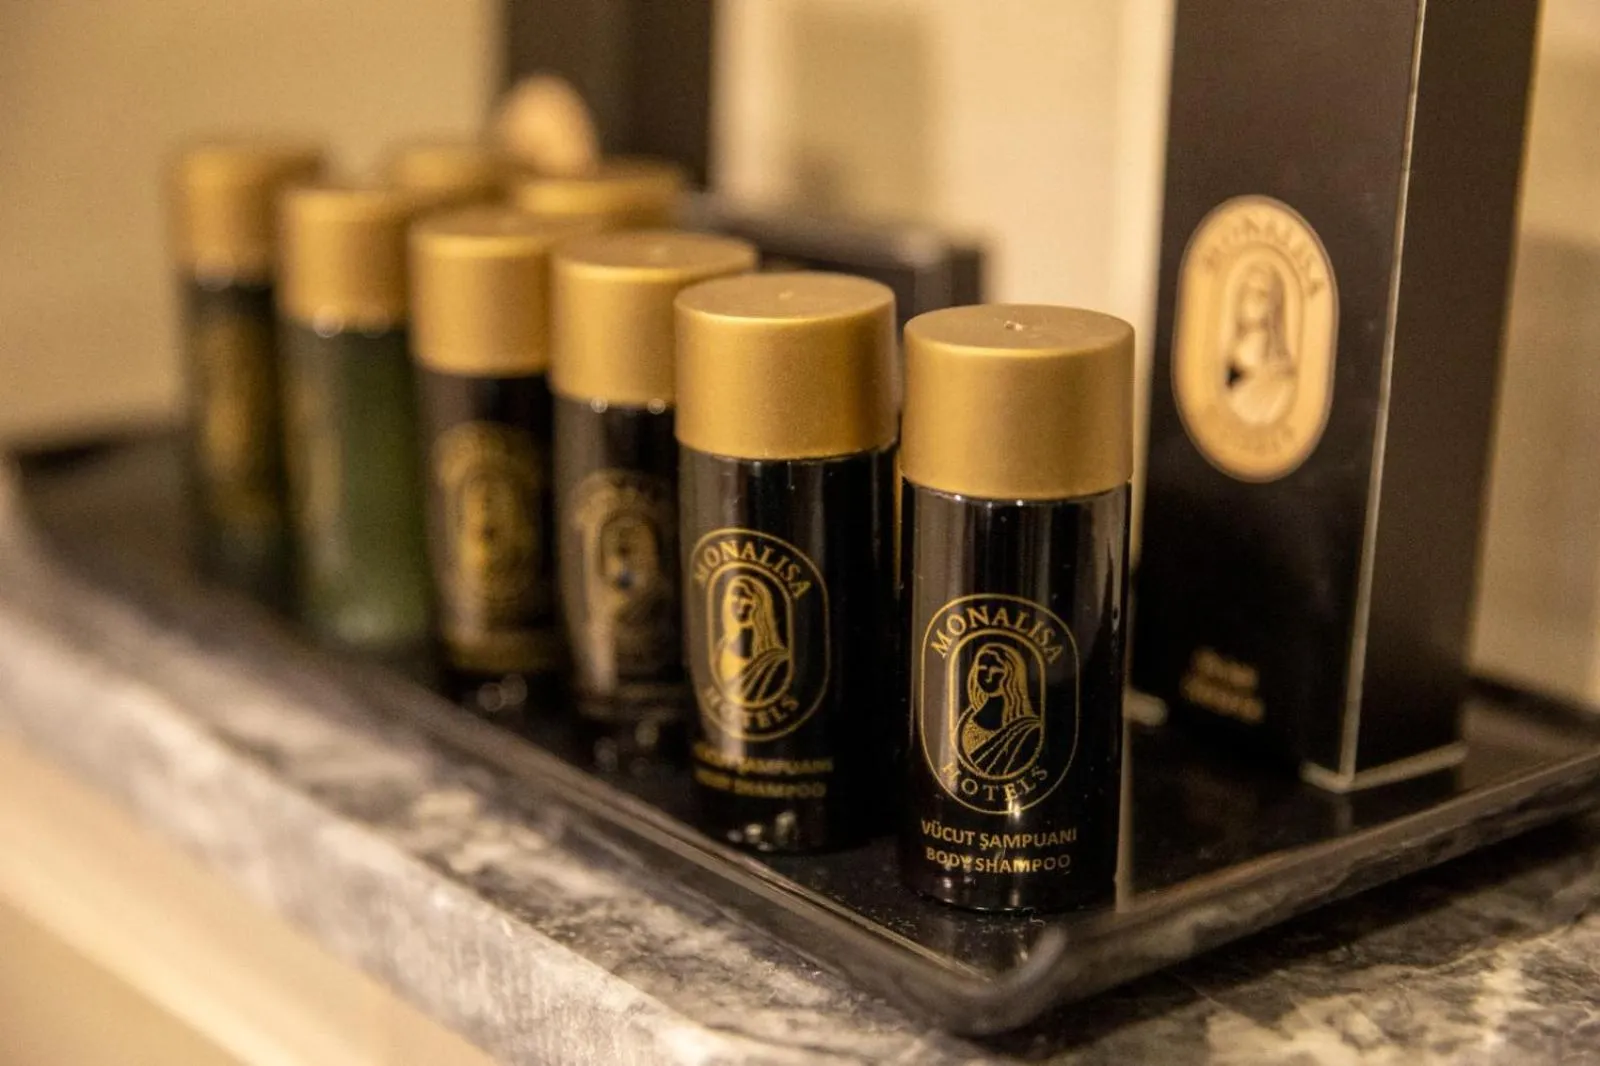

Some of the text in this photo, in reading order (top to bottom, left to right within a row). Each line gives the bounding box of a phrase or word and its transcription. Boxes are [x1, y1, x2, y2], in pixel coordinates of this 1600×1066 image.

[930, 605, 1064, 664] MONALISA
[942, 765, 1049, 802] HOTELS
[921, 820, 1077, 850] VÜCUT ŞAMPUANI
[926, 847, 1071, 873] BODY SHAMPOO
